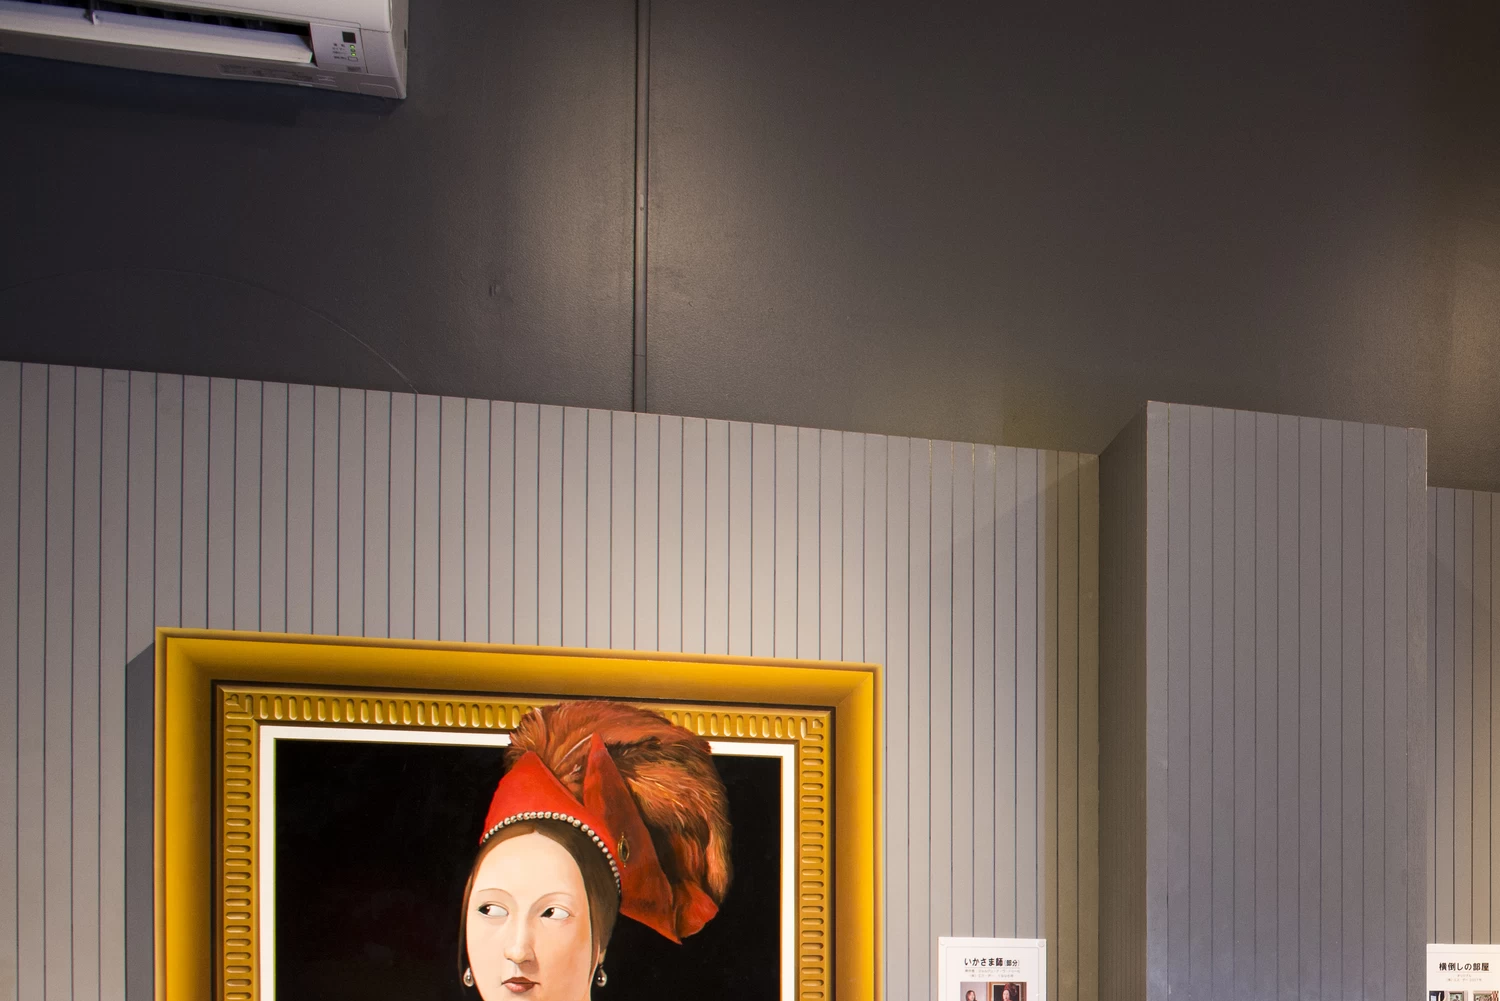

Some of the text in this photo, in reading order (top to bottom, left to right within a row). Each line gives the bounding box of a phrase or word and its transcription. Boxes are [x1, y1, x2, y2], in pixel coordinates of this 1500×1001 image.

[1439, 962, 1489, 971] 横倒しの部屋
